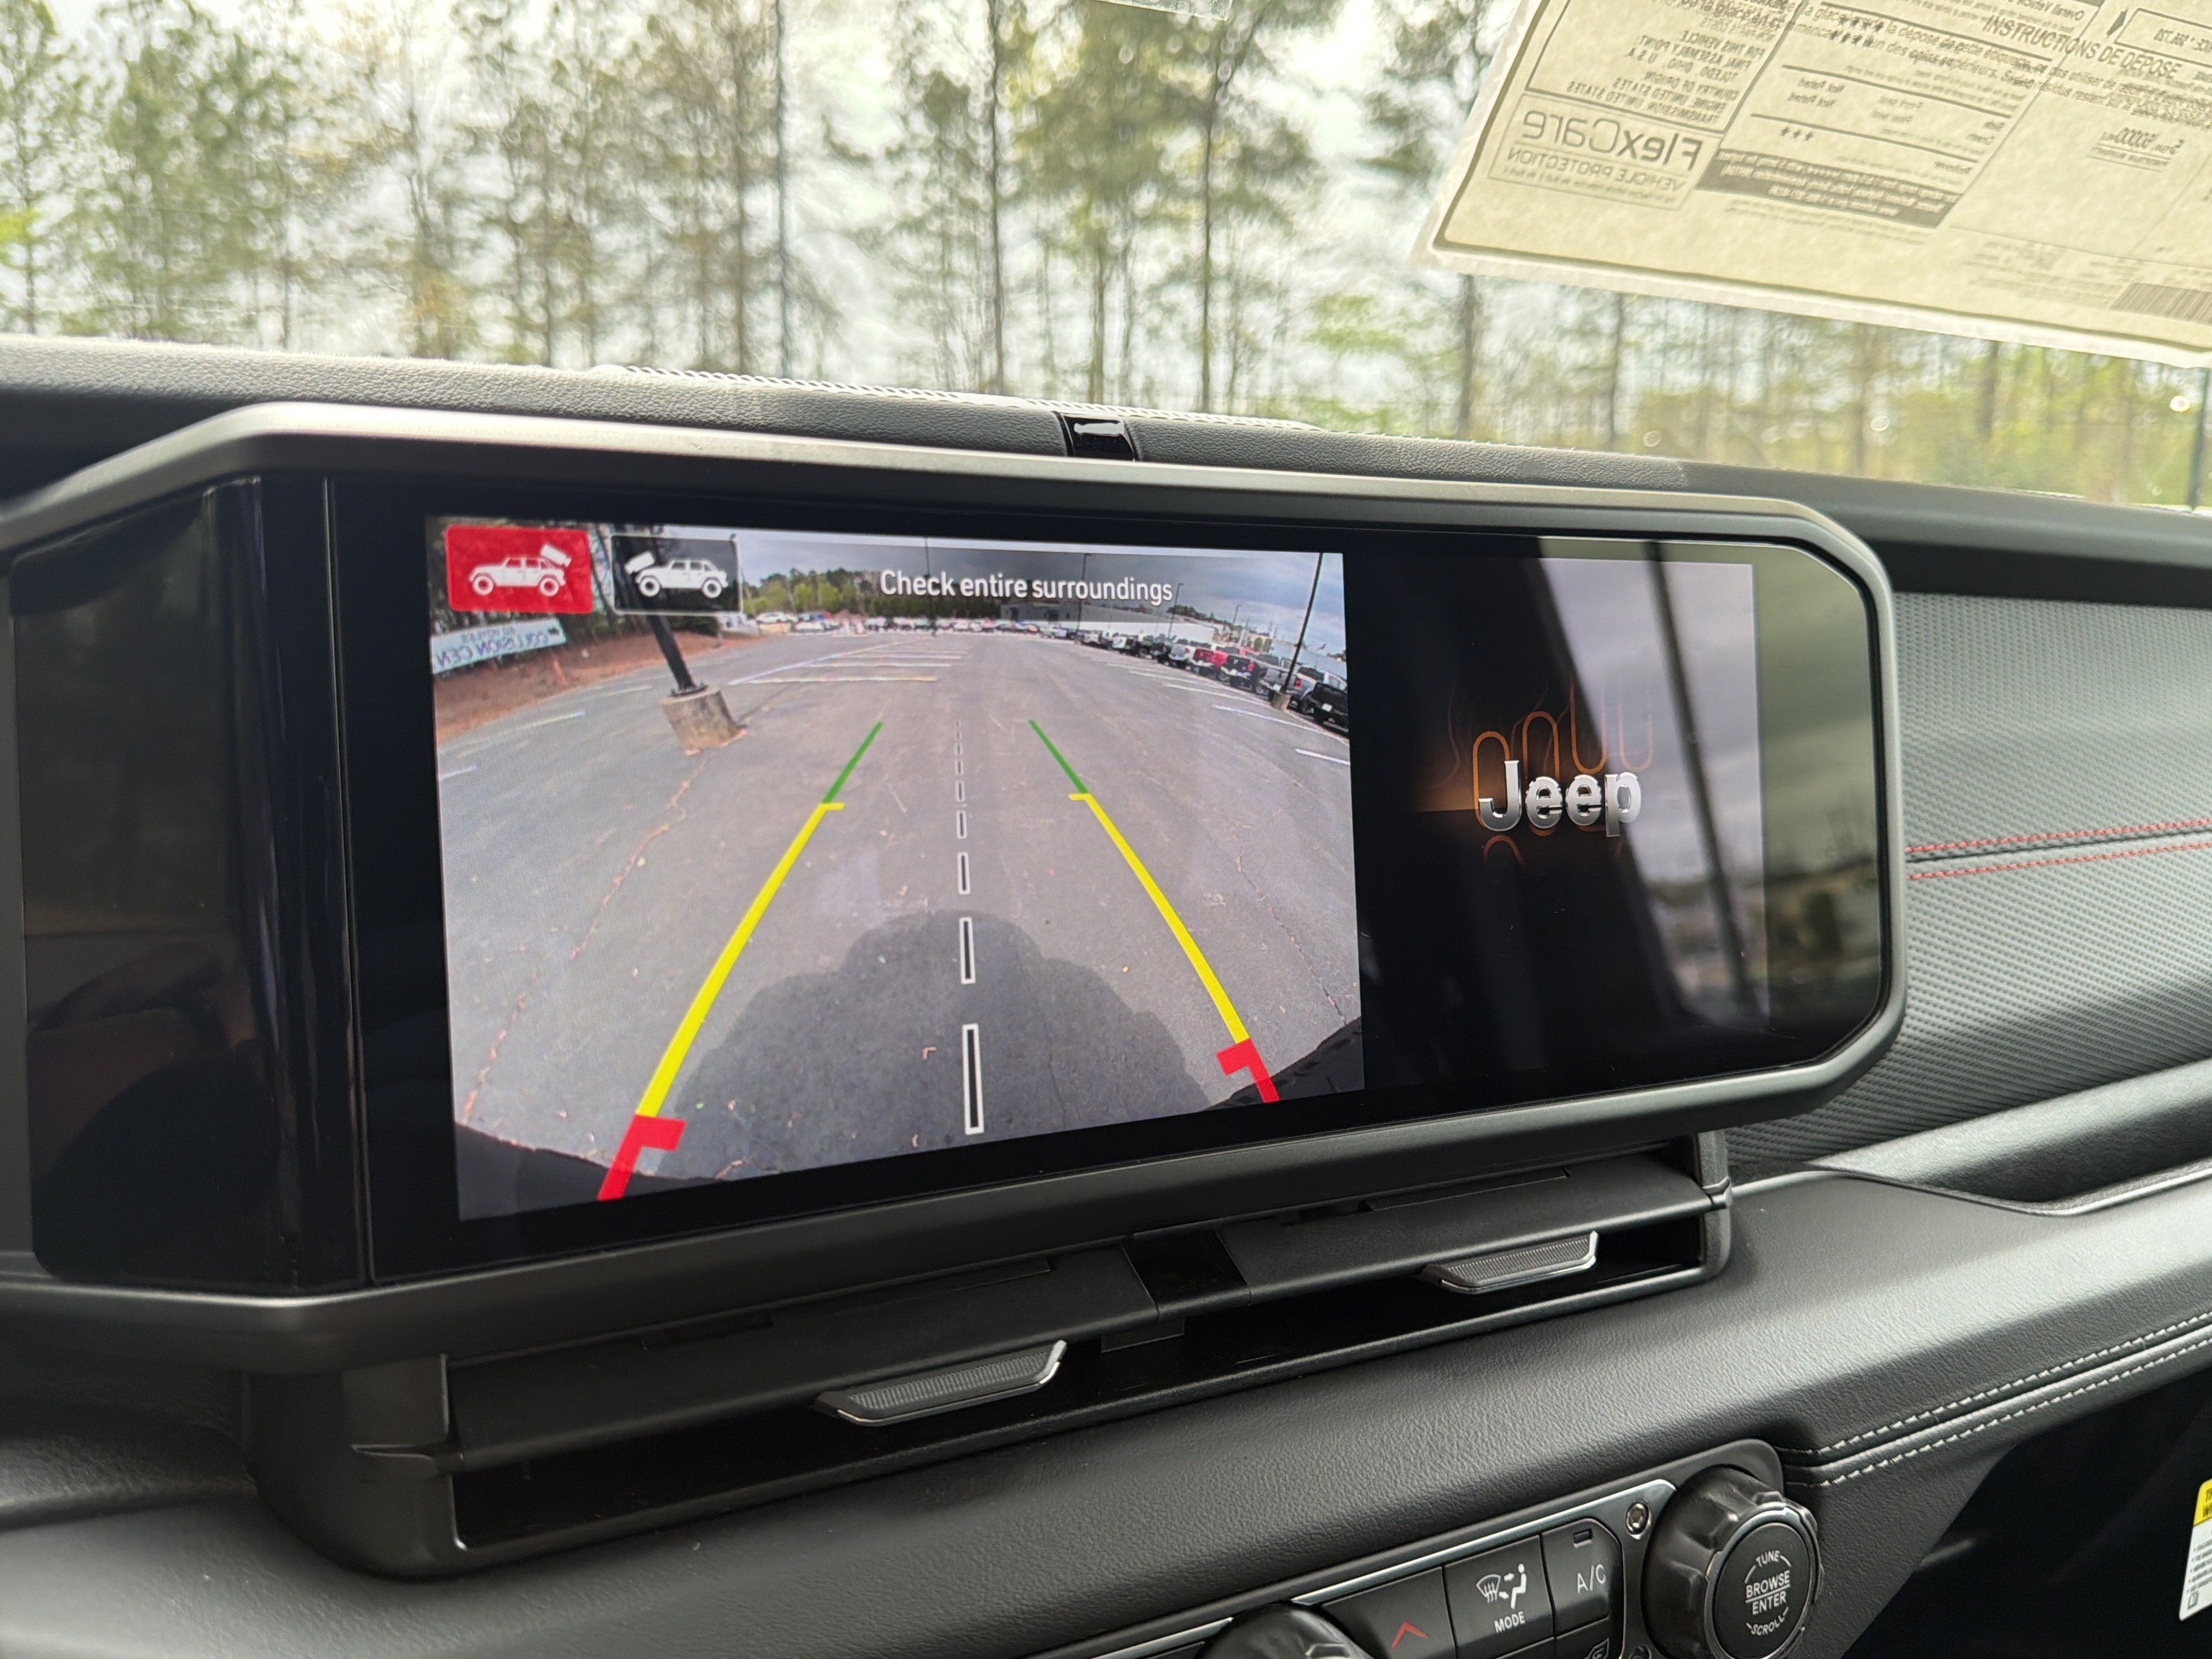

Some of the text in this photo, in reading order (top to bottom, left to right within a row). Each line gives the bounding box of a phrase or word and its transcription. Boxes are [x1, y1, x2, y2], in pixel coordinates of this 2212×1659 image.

[1982, 15, 2101, 59] INSTRUCTIONS
[2097, 46, 2125, 65] DE
[879, 570, 1173, 606] Check entire surroundings
[1478, 760, 1642, 838] Jeep
[1755, 1550, 1781, 1568] TUNE
[1577, 1564, 1606, 1594] A/C
[1746, 1570, 1791, 1599] BROWSE
[1752, 1590, 1787, 1615] ENTER
[1494, 1611, 1526, 1633] MODE
[1751, 1615, 1785, 1636] SCROLL
